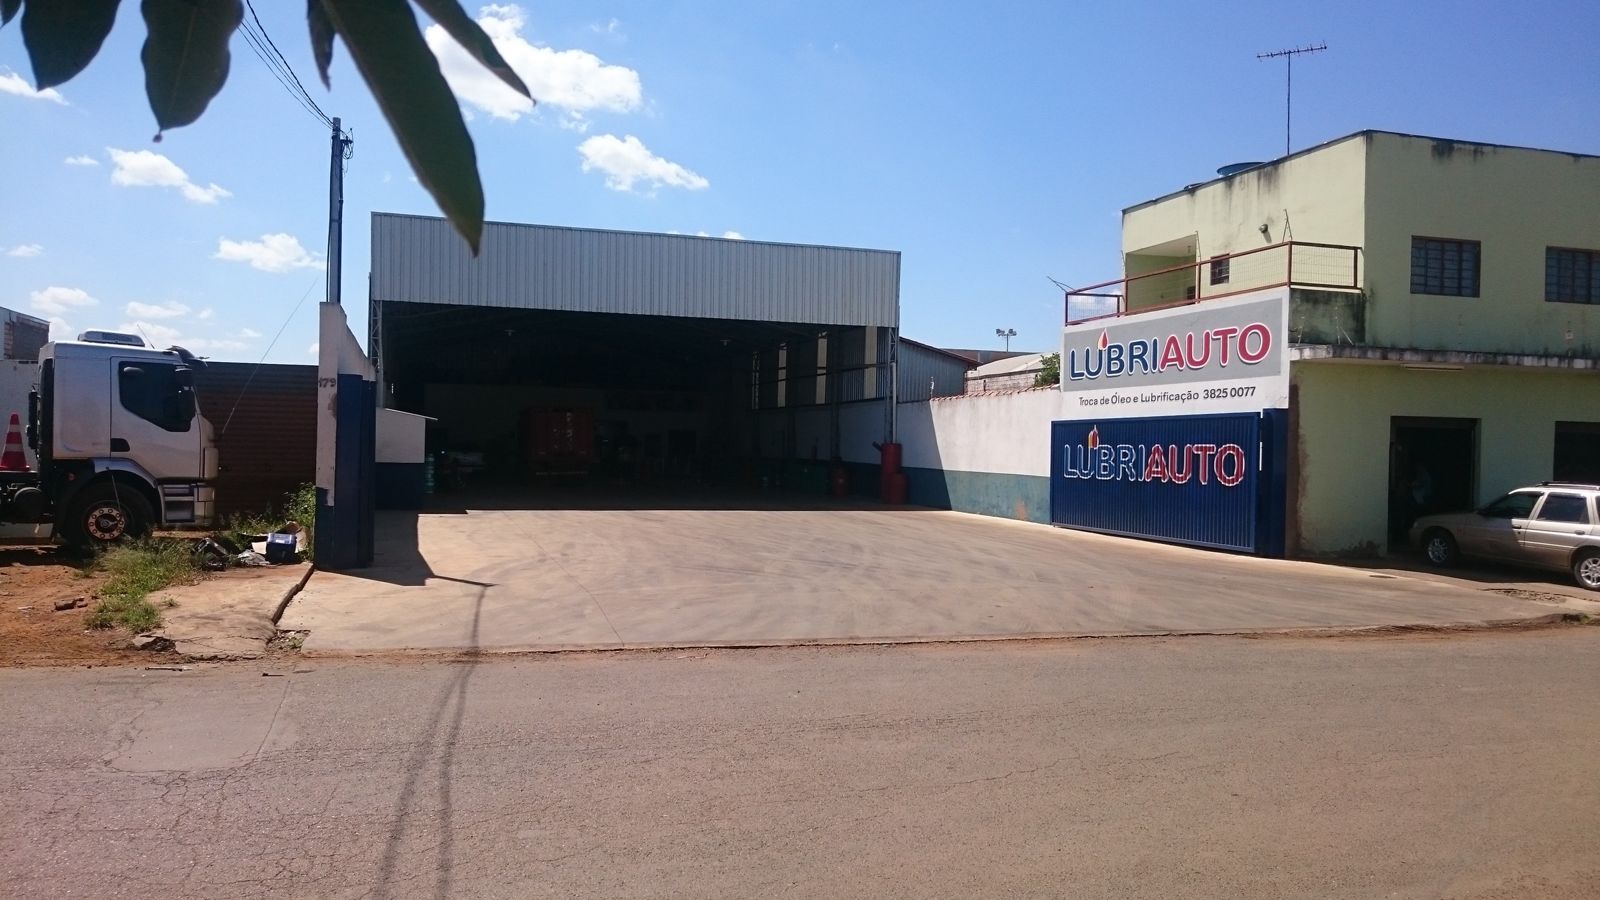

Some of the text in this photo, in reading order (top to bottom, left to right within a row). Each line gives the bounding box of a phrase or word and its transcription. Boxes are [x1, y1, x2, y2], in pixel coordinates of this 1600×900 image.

[1069, 323, 1272, 380] LUBRIAUTO
[1079, 396, 1098, 406] Troca
[1100, 397, 1110, 405] de
[1111, 391, 1131, 405] Óleo
[1141, 390, 1199, 403] Lubrificação
[1203, 387, 1228, 399] 3825
[1230, 386, 1256, 398] 0077
[1064, 443, 1246, 487] LUBRIAUTO
